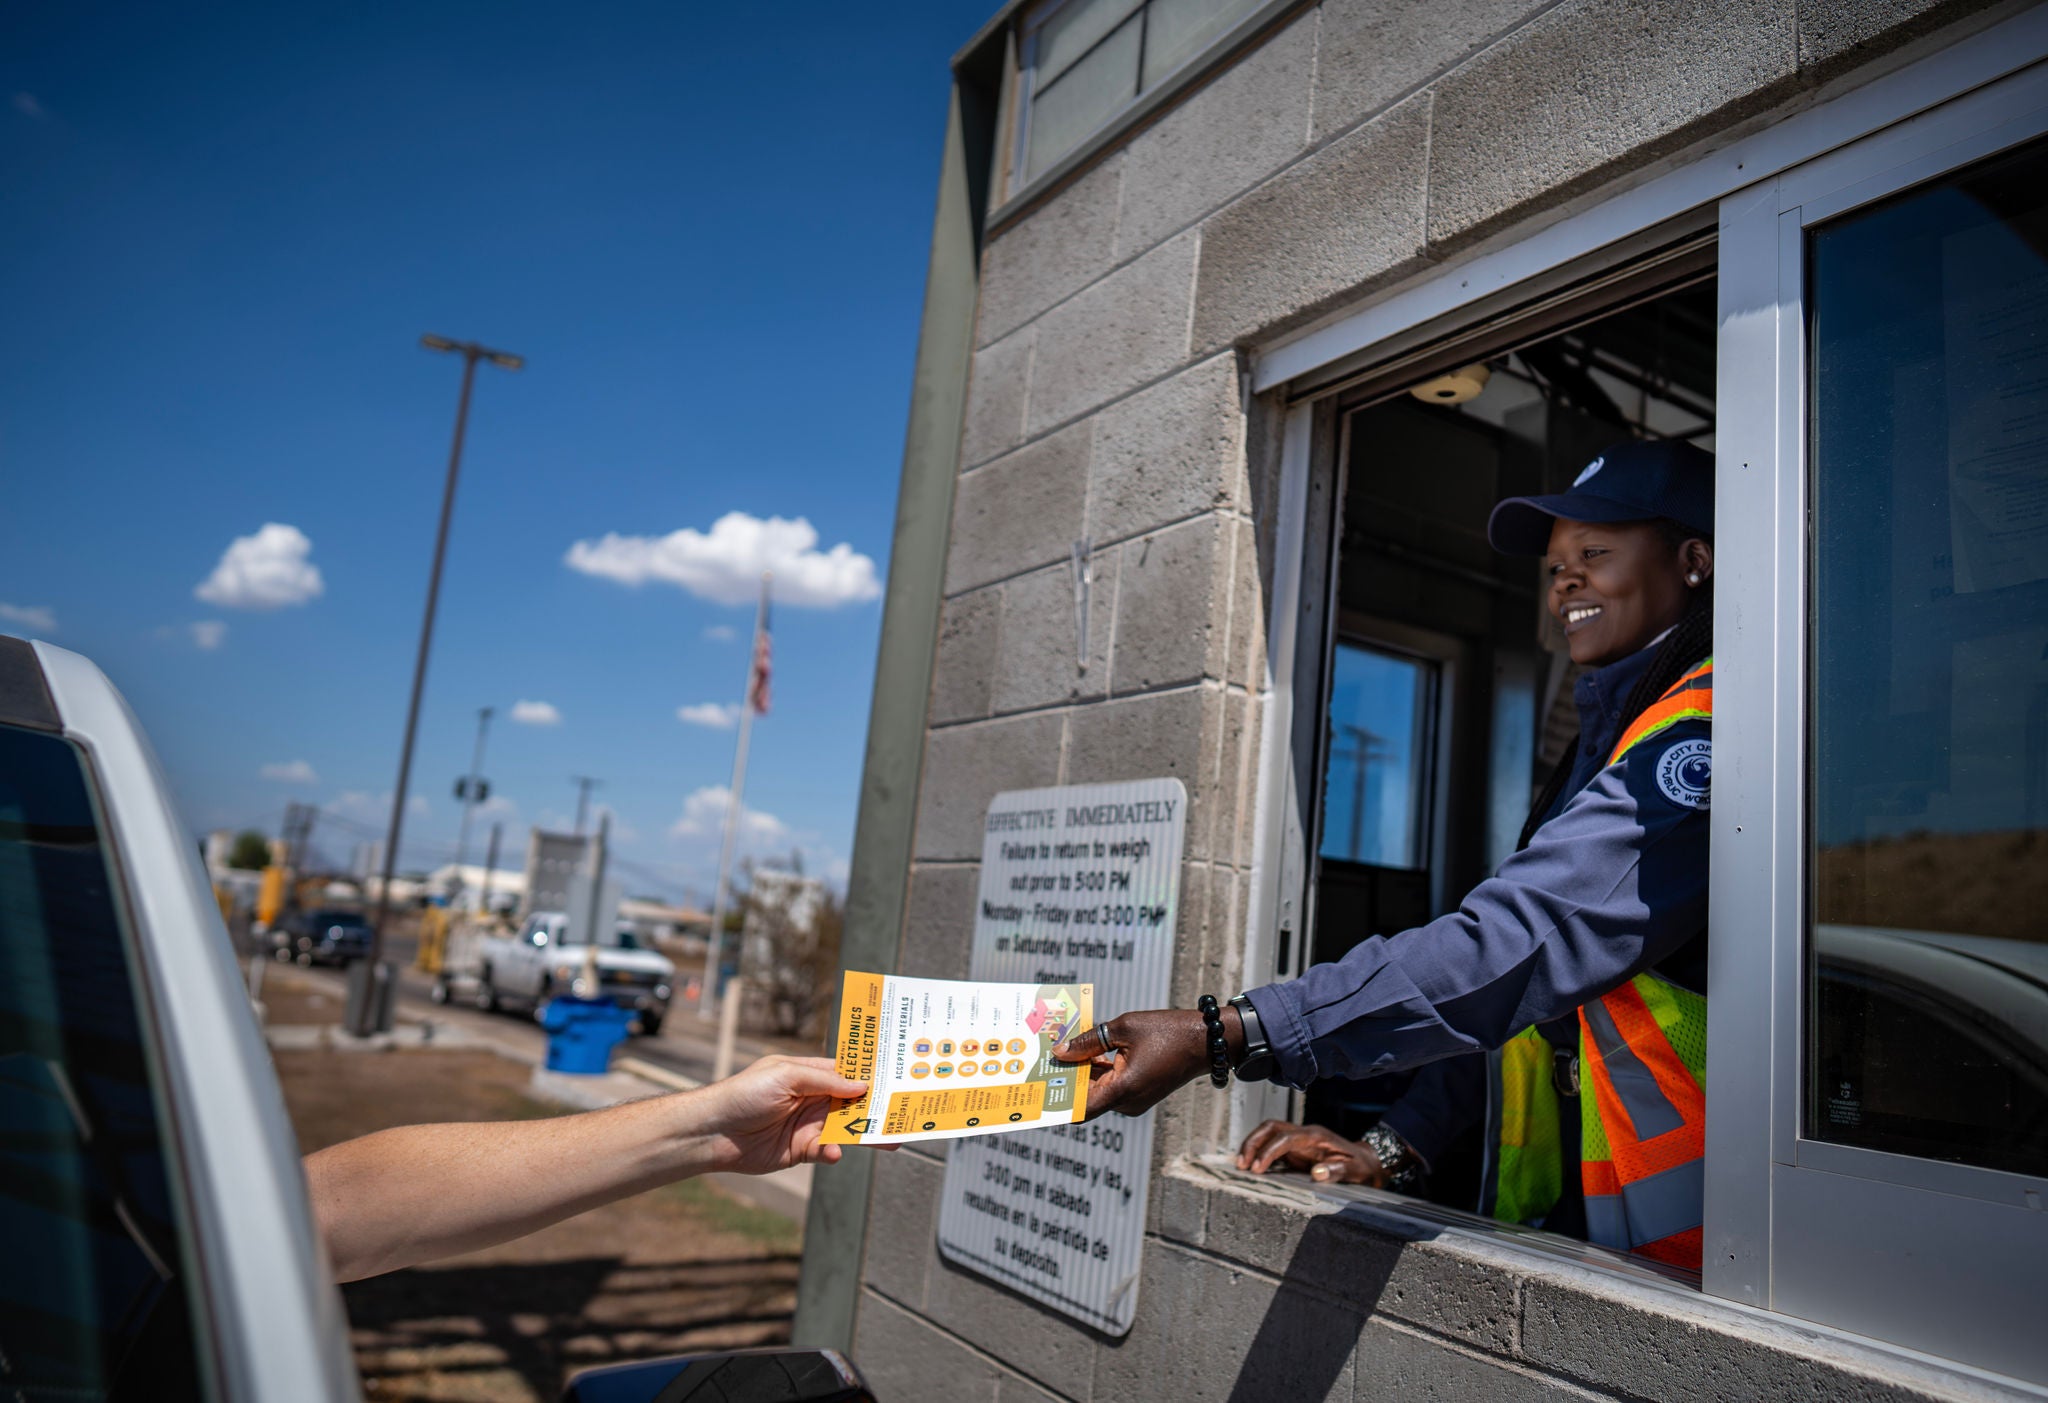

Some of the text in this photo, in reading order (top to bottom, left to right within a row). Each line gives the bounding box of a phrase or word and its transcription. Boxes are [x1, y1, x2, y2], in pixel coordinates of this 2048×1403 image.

[1670, 744, 1692, 761] CITY
[1662, 765, 1681, 796] PUBLIC
[986, 800, 1177, 833] EFFECTIVE IMMEDIATELY
[1001, 836, 1151, 863] Failure to return to weigh
[1010, 870, 1131, 894] out prior to 5:00 PM
[982, 900, 1024, 926] Monday
[1033, 902, 1070, 928] Friday
[1074, 905, 1099, 926] and
[1101, 904, 1135, 927] 3:00
[1137, 905, 1161, 928] PM
[996, 933, 1135, 963] on Saturday forfeits full
[845, 1006, 862, 1080] ELECTRONICS
[860, 1015, 877, 1081] COLLECTION
[896, 996, 909, 1080] ACCEPTED MATERIALS
[886, 1122, 895, 1134] HOW
[1091, 1125, 1124, 1154] 5:00
[986, 1134, 999, 1151] de
[1003, 1135, 1032, 1161] lunes
[1033, 1149, 1042, 1164] a
[1045, 1150, 1087, 1180] viernes
[1090, 1166, 1101, 1188] y
[1103, 1165, 1122, 1191] las
[982, 1161, 1013, 1188] 3:00
[1011, 1175, 1031, 1196] pm
[1034, 1181, 1047, 1200] el
[994, 1236, 1008, 1256] su
[1011, 1208, 1027, 1229] en
[1029, 1210, 1041, 1234] la
[1091, 1237, 1109, 1262] de
